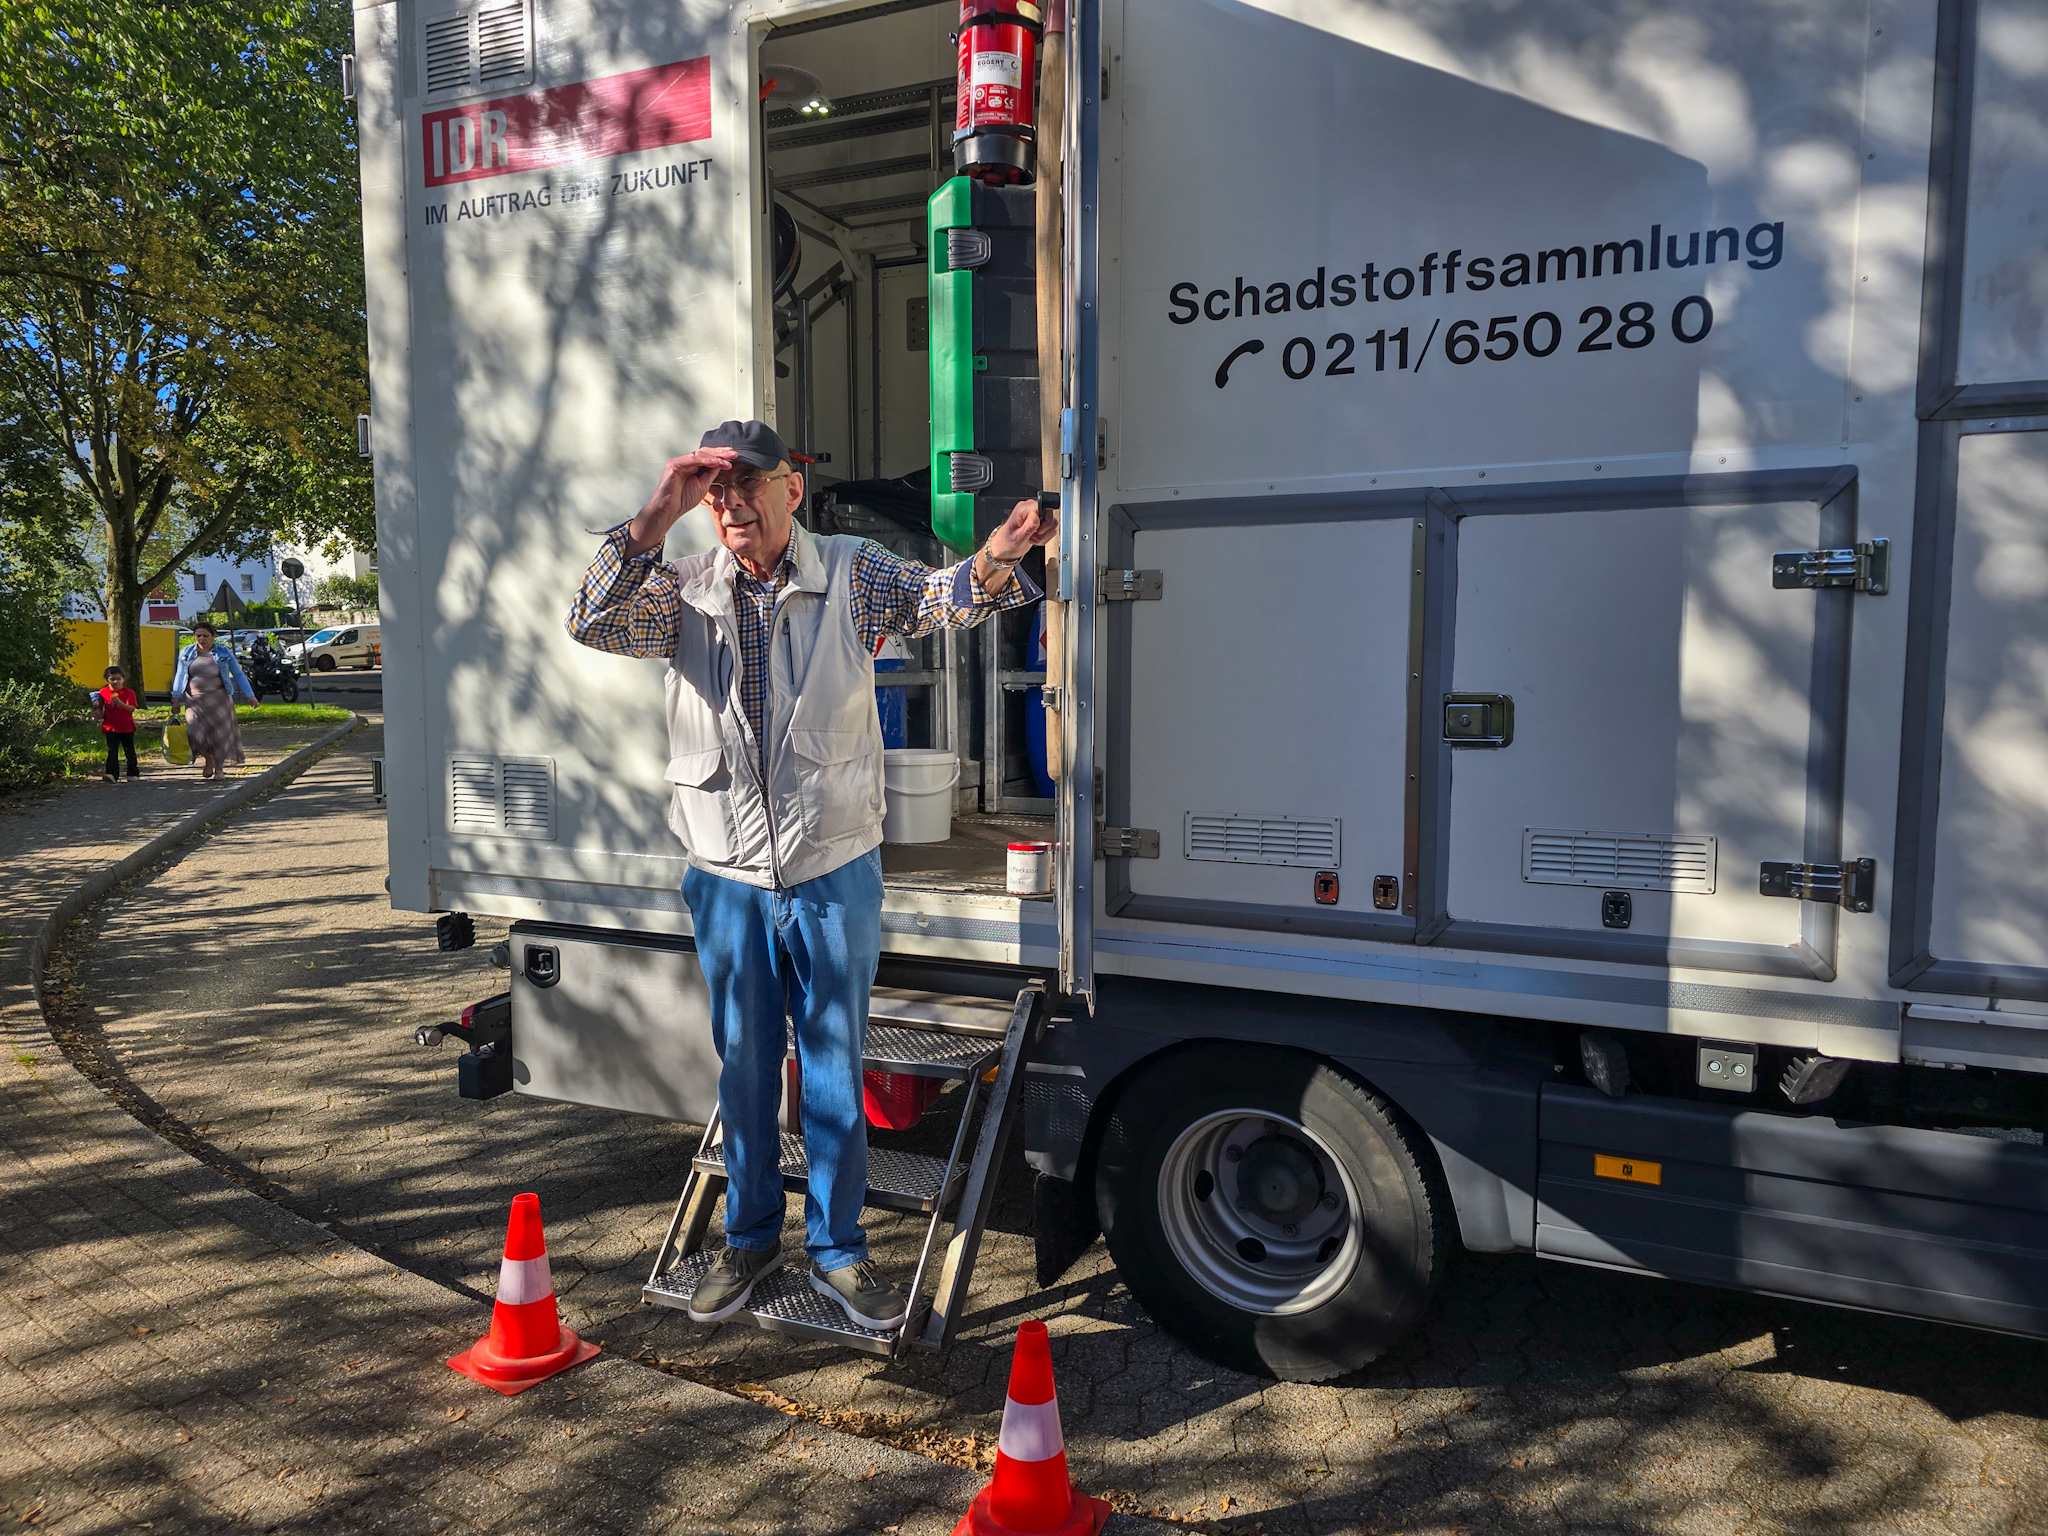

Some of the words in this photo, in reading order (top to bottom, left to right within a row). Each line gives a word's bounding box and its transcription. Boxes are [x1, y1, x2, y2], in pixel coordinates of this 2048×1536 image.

[431, 109, 509, 178] IDR
[425, 203, 448, 226] IM
[456, 186, 552, 222] AUFTRAG
[560, 177, 601, 204] DER
[611, 158, 713, 196] ZUKUNFT
[1168, 220, 1785, 325] Schadstoffsammlung
